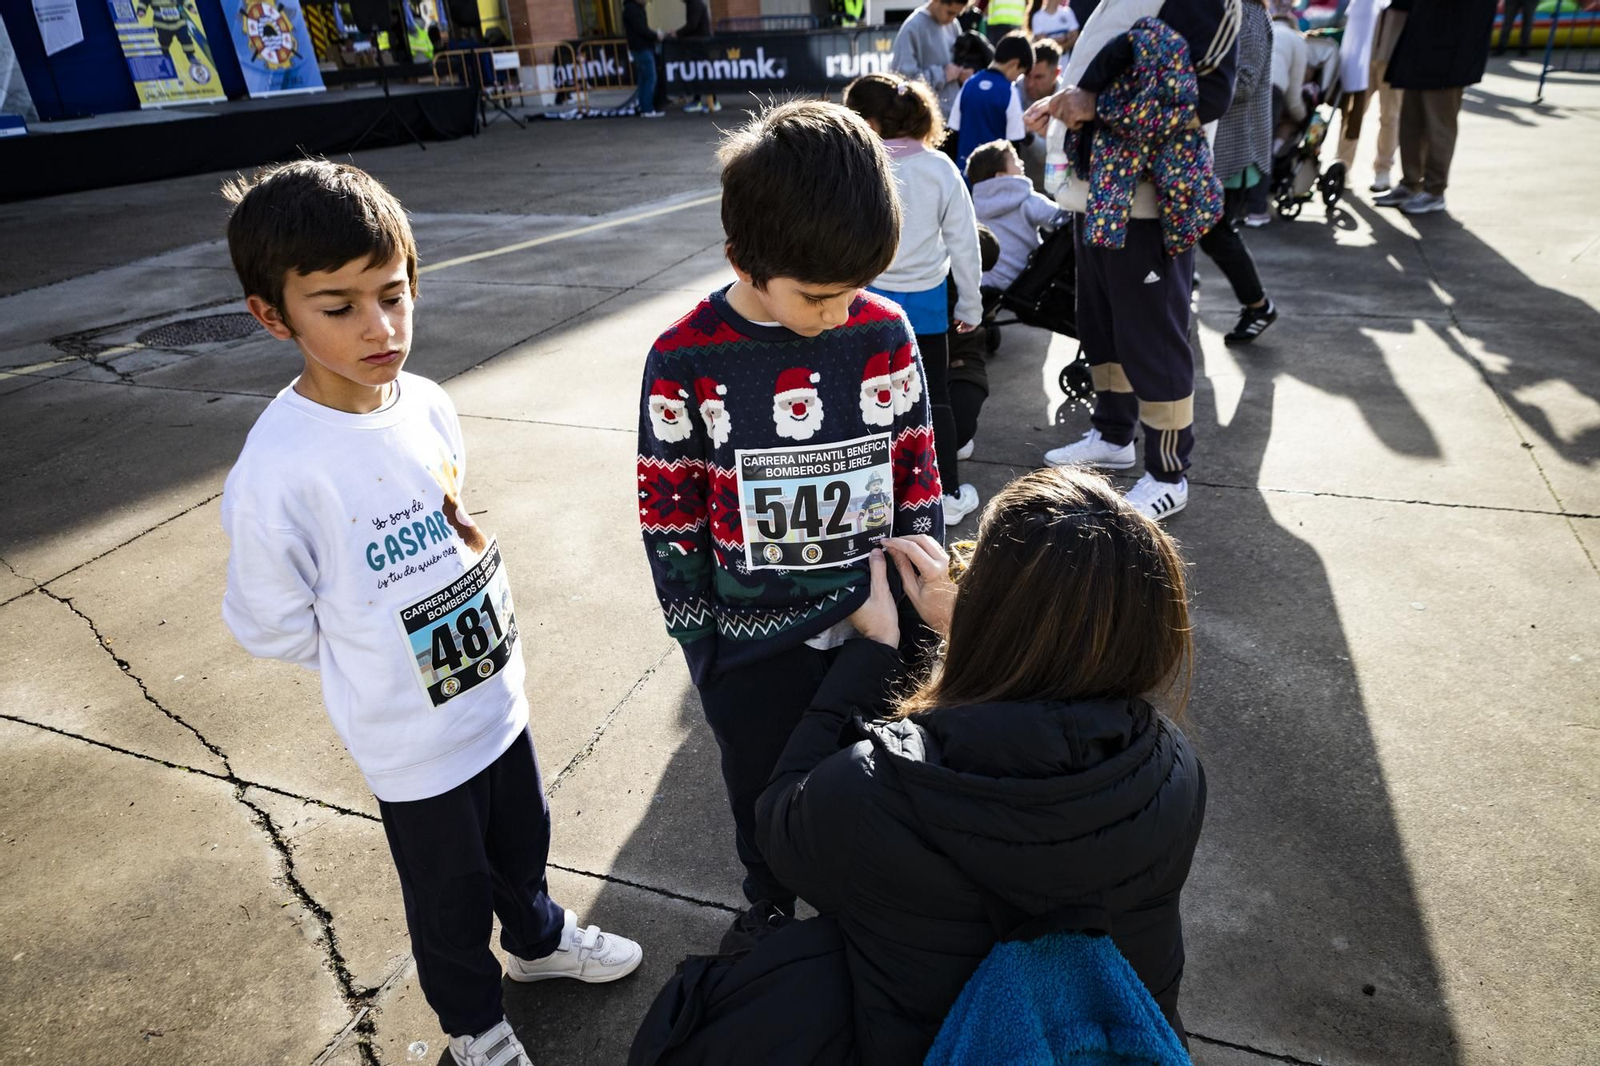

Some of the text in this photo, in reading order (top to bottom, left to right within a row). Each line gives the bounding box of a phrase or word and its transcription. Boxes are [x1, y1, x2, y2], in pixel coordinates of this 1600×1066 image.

[743, 440, 887, 467] CARRERA INFANTIL BENÉFICA
[765, 455, 872, 478] BOMBEROS DE JEREZ
[372, 499, 424, 530] Yo soy de
[753, 480, 852, 539] 542
[366, 510, 452, 571] GASPAR
[403, 590, 452, 620] CARRERA
[451, 566, 483, 596] INFANTIL
[404, 565, 417, 576] de
[427, 584, 477, 620] BOMBEROS
[476, 575, 486, 588] DE
[432, 592, 503, 671] 481
